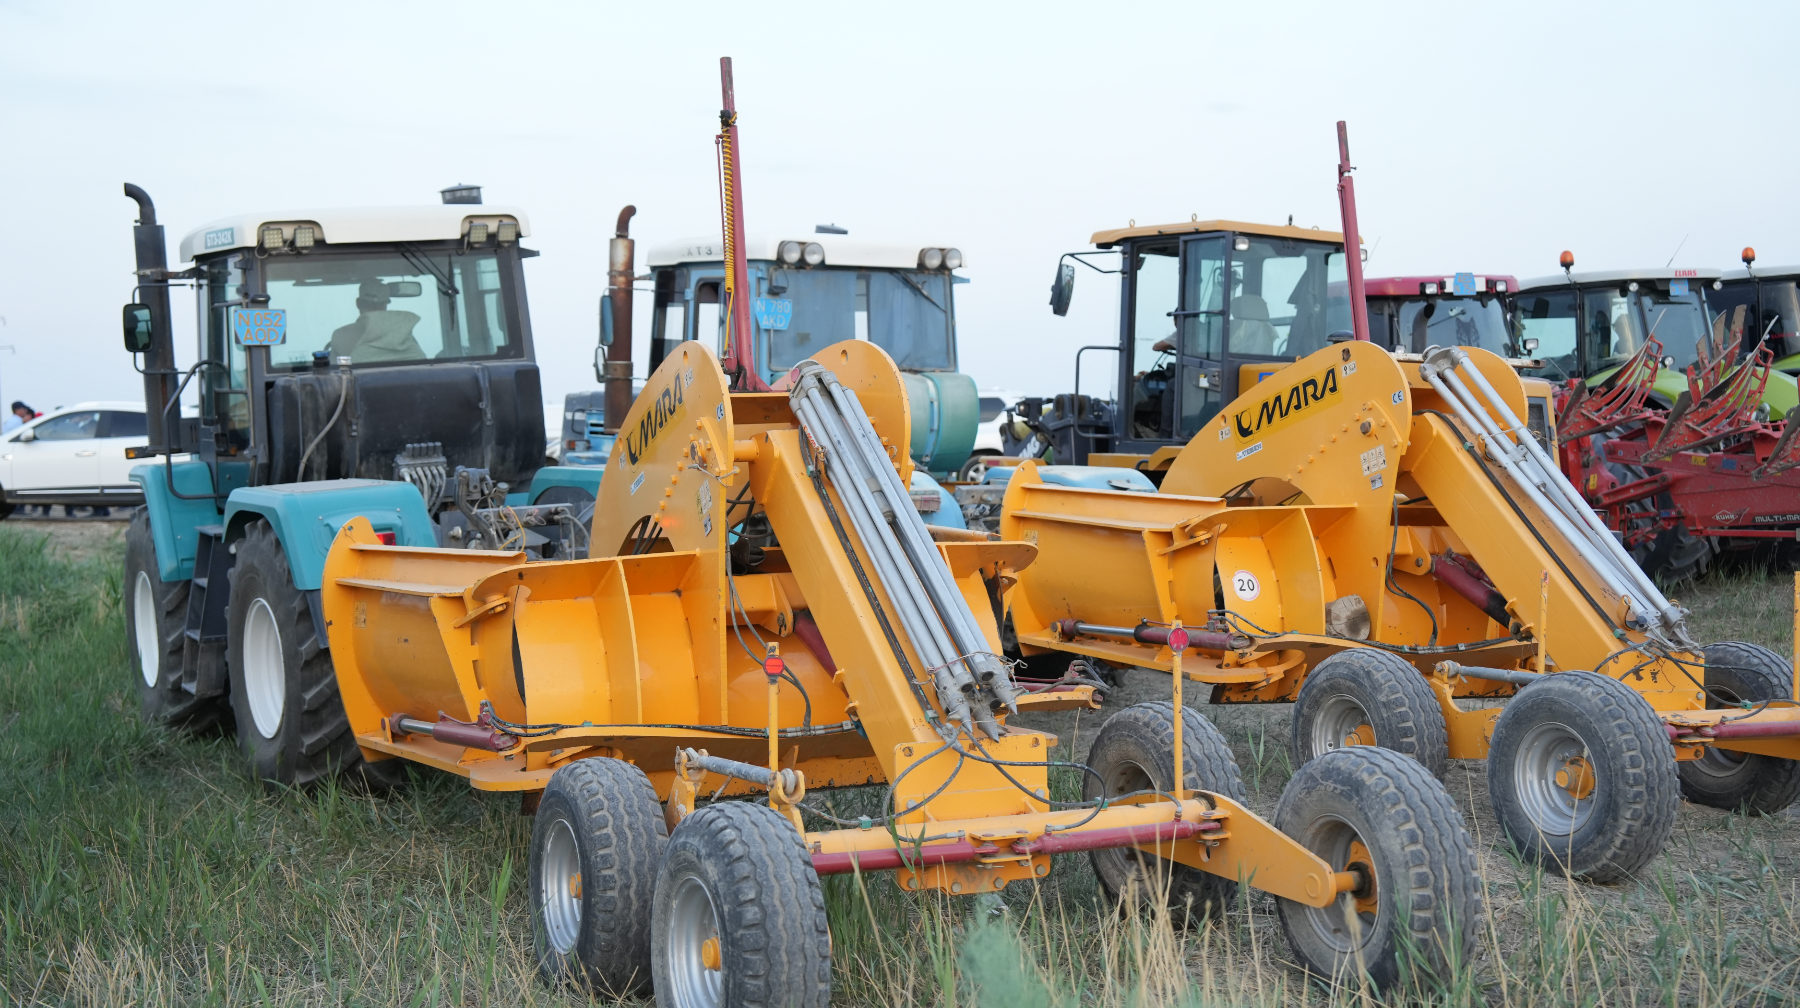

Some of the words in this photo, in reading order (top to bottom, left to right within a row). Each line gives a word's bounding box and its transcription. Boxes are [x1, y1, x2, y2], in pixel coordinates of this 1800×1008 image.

[1674, 269, 1697, 277] CLAAS
[757, 299, 766, 312] N
[770, 300, 790, 313] 780
[238, 312, 250, 327] N
[254, 312, 283, 327] 052
[762, 314, 786, 327] AKD
[1237, 578, 1255, 592] 20
